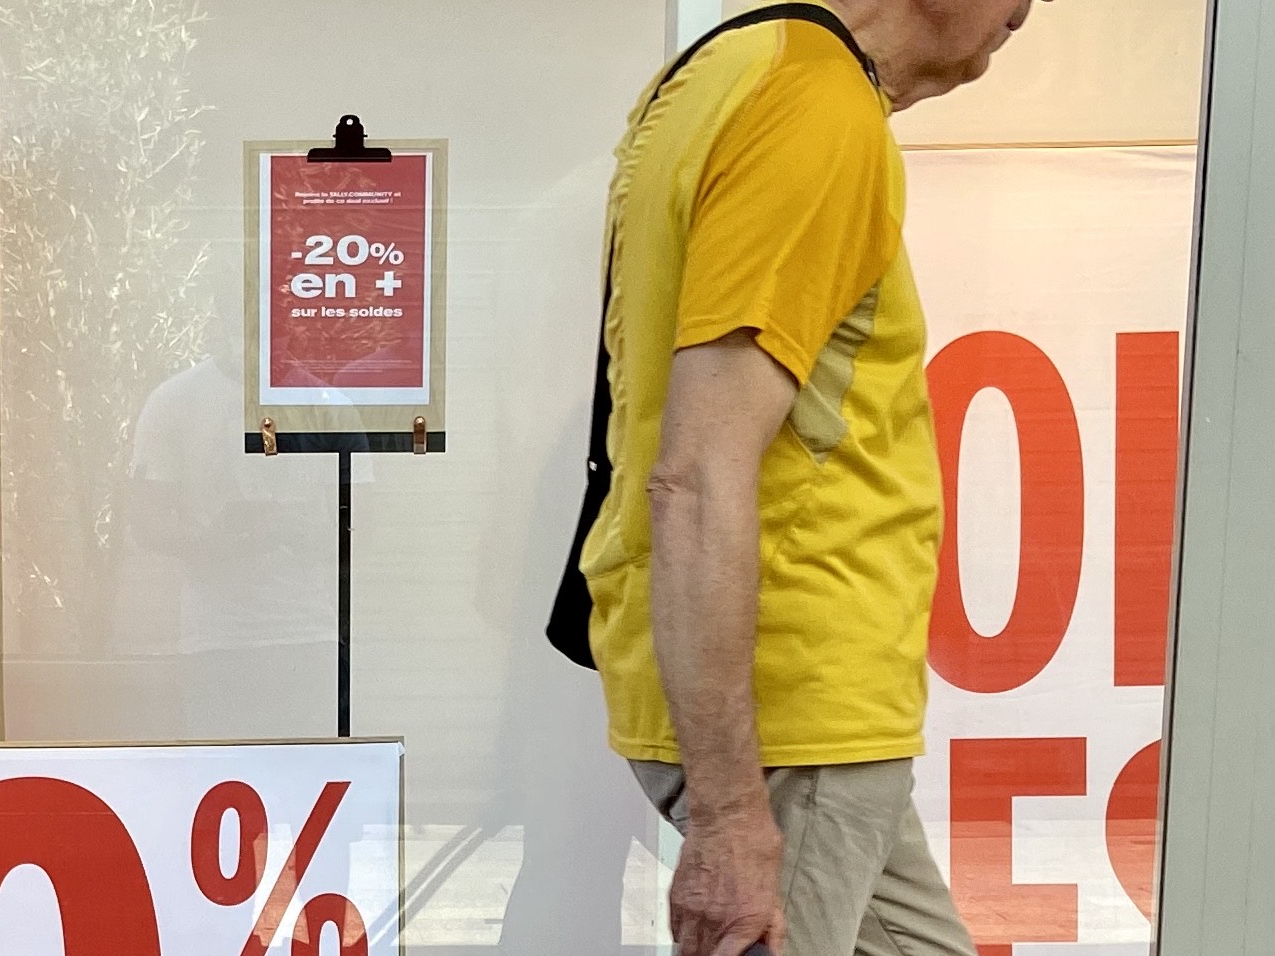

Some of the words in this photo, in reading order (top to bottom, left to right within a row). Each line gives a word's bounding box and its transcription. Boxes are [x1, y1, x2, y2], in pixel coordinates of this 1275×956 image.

[291, 234, 405, 266] -20%
[290, 272, 356, 299] en
[375, 270, 402, 297] +
[291, 308, 317, 318] sur
[321, 306, 345, 318] les
[349, 306, 404, 318] soldes
